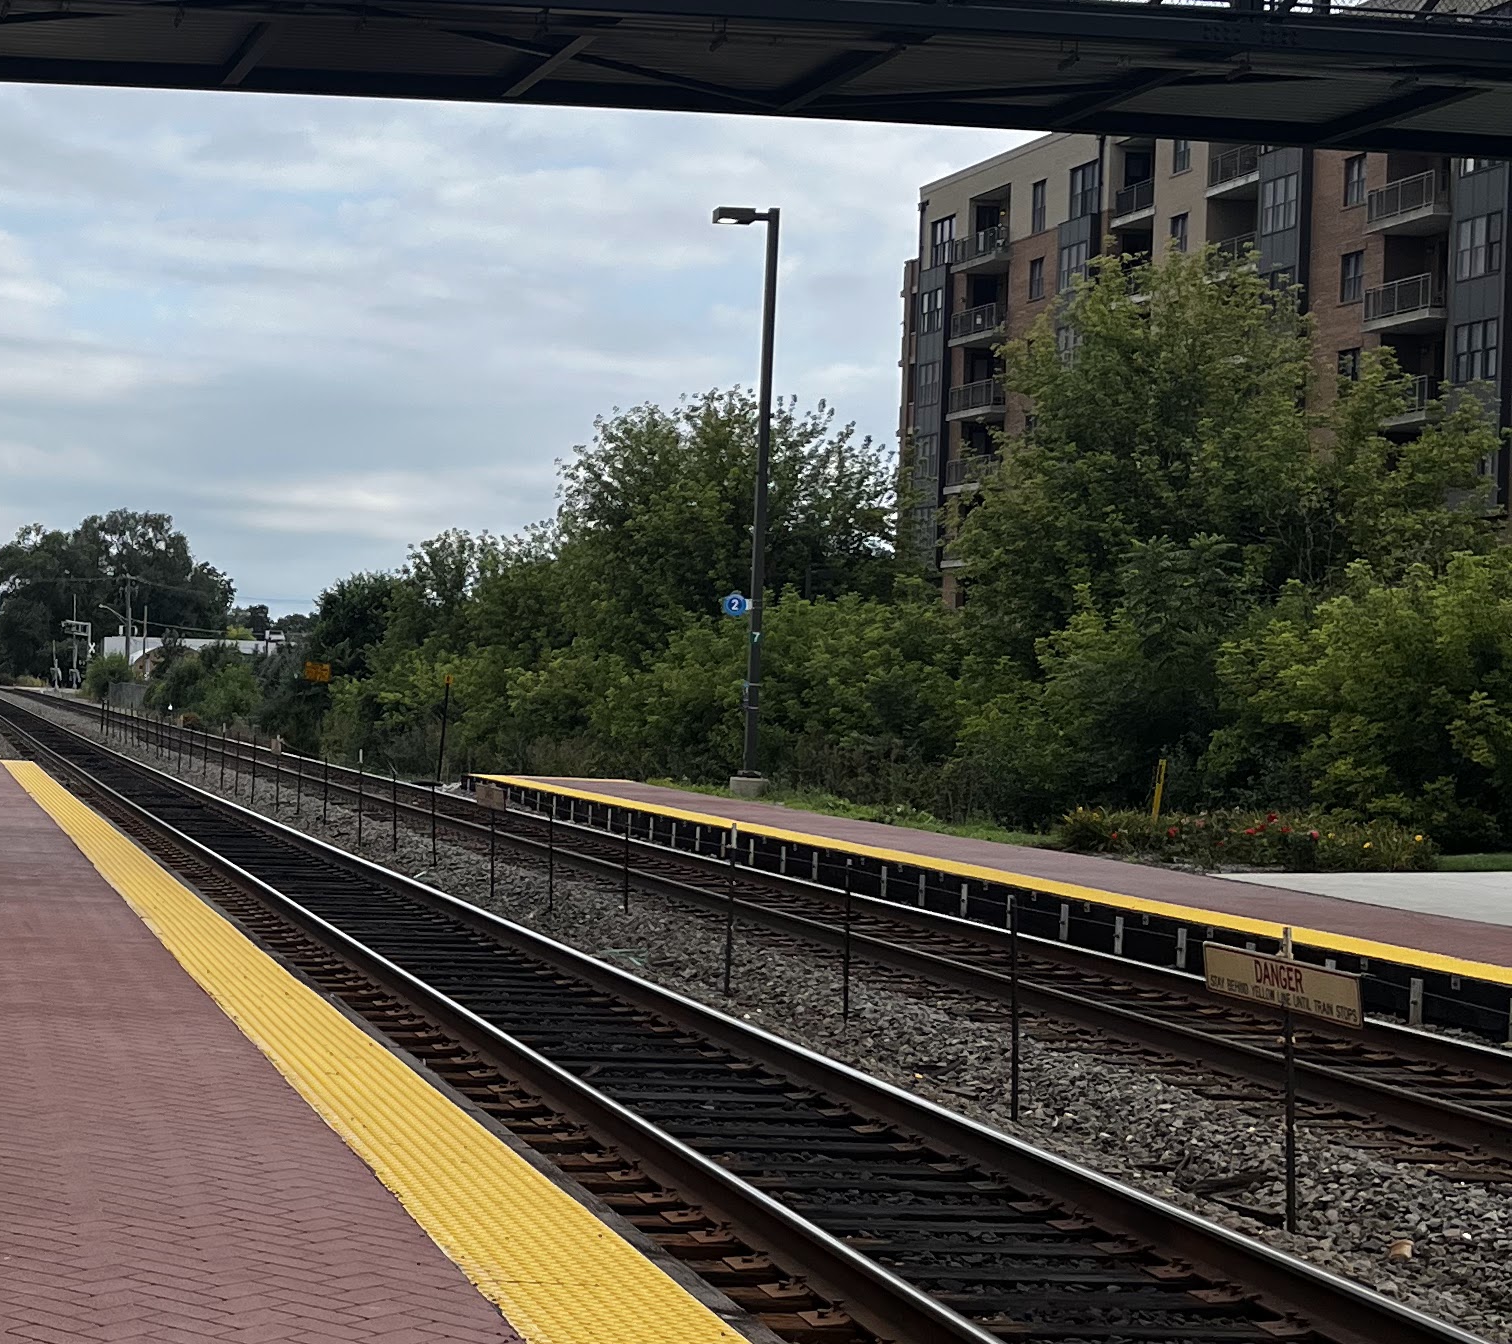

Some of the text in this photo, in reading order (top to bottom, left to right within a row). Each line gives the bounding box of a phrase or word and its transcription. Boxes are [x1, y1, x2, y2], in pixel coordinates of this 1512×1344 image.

[731, 599, 739, 611] 2
[752, 631, 761, 643] 7
[1254, 959, 1304, 994] DANGER
[1210, 974, 1358, 1023] STAY BEHIND YELLOW LINE UNTIL TRAIN STOPS
